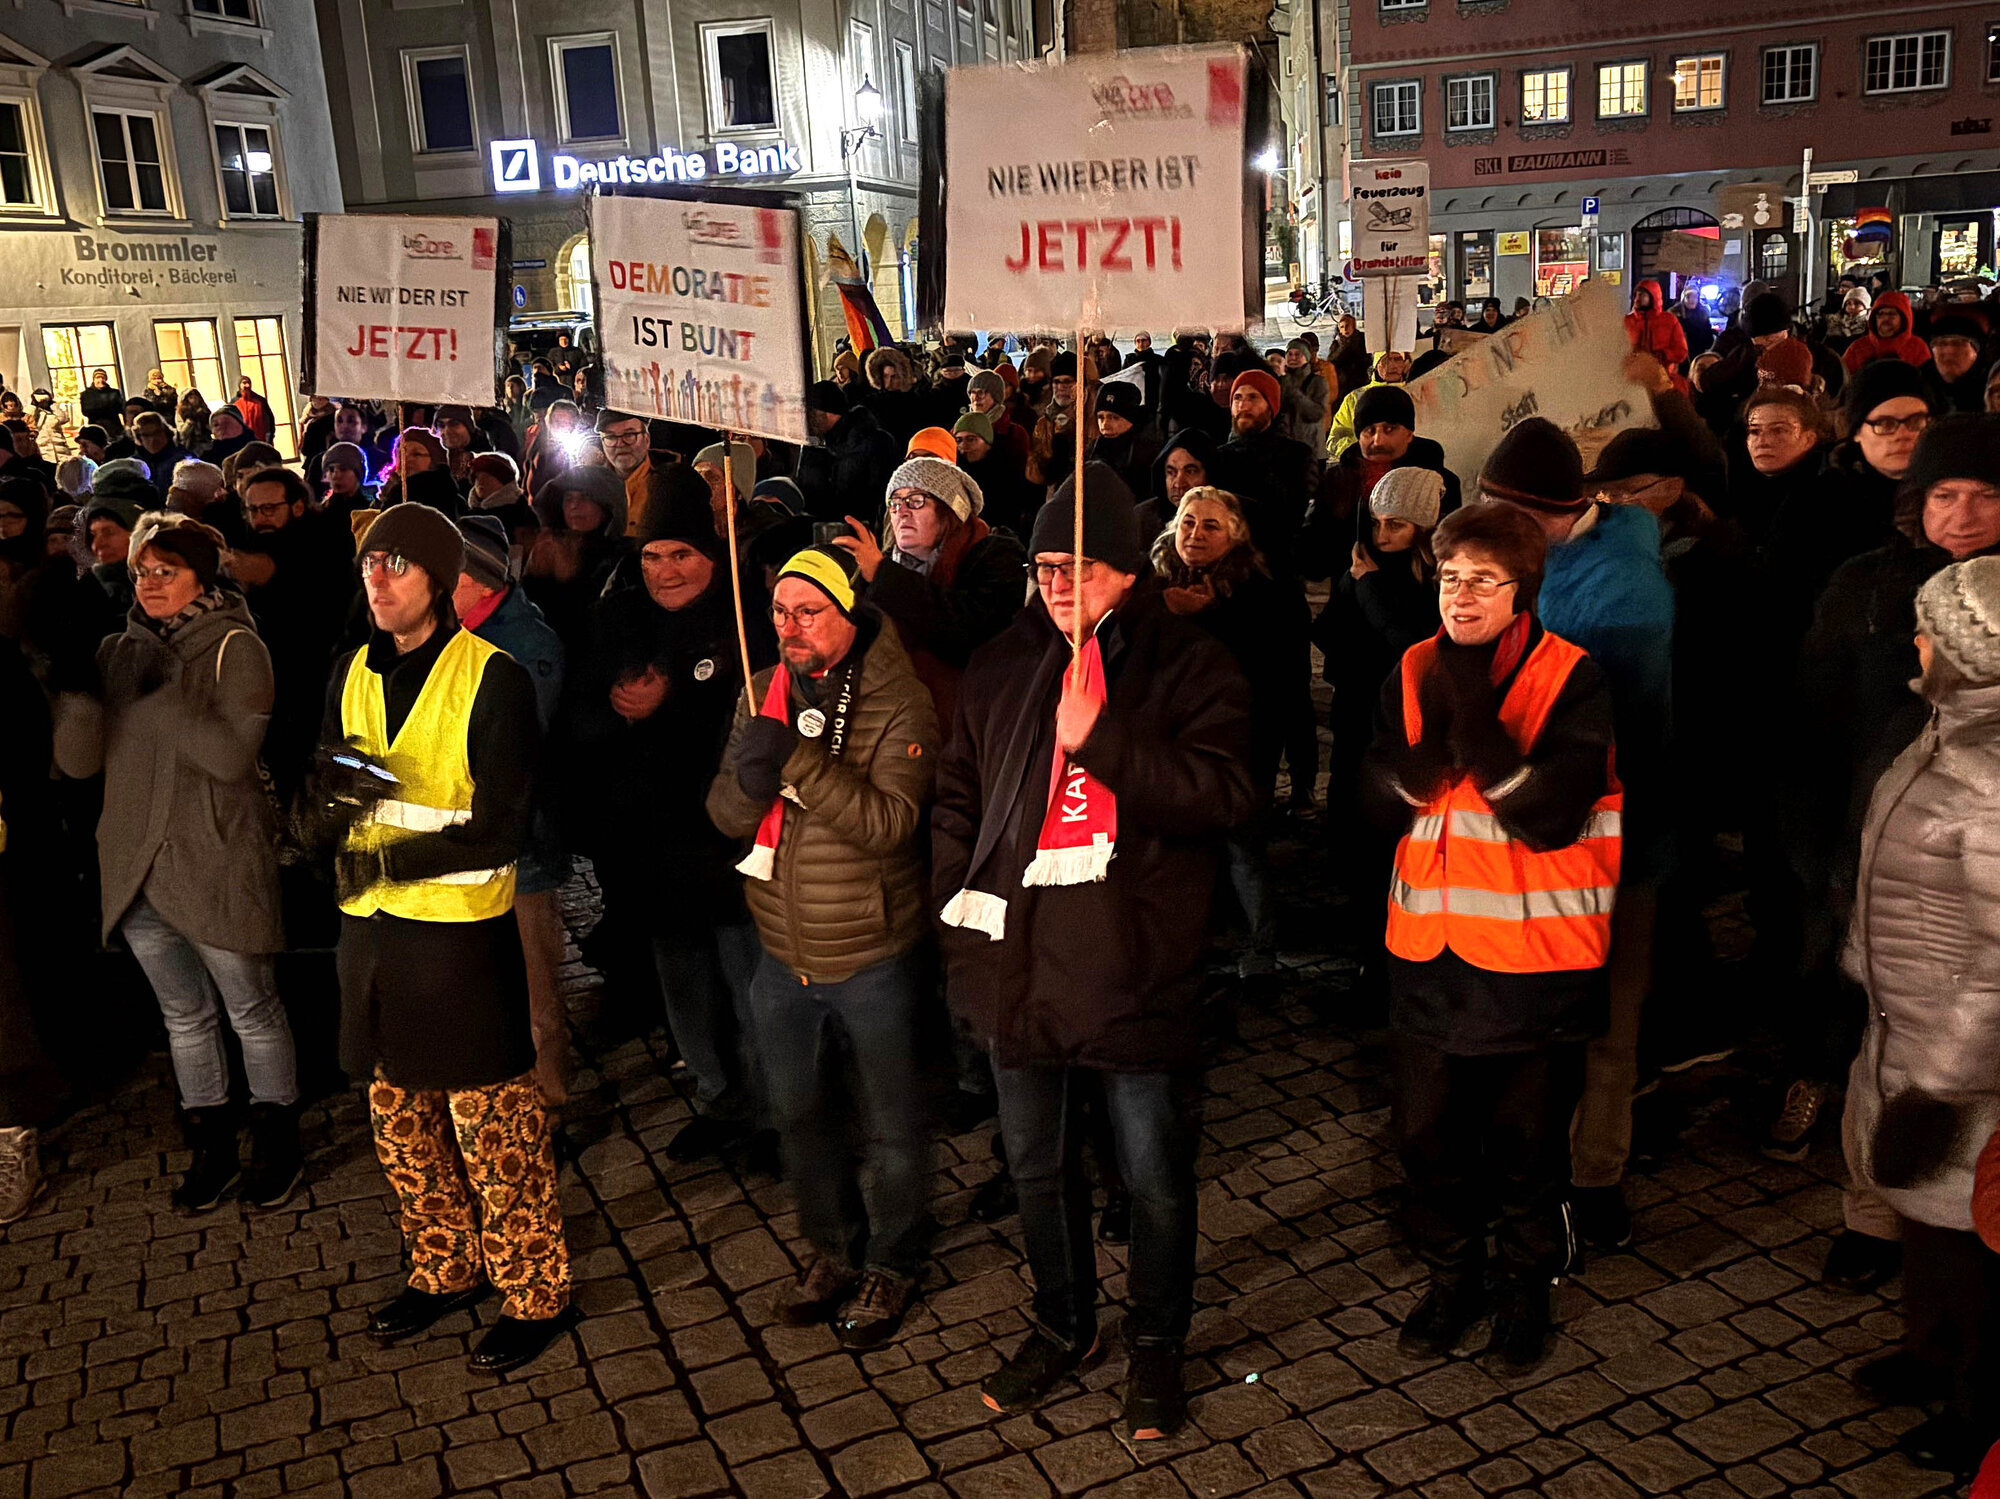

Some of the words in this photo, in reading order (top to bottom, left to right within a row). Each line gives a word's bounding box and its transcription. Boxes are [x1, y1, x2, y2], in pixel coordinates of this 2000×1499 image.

[553, 147, 706, 188] Deutsche
[716, 142, 800, 174] Bank
[1375, 168, 1402, 180] kein
[1476, 158, 1501, 174] SKL
[1512, 151, 1602, 171] BAUMANN
[988, 163, 1032, 199] NIE
[1038, 157, 1148, 195] WIEDER
[1155, 155, 1201, 190] IST
[1353, 186, 1425, 199] Feuerzeug
[1585, 199, 1596, 213] P
[74, 235, 217, 262] Brommler
[1005, 216, 1183, 272] JETZT!
[1381, 241, 1398, 251] für
[1353, 256, 1426, 270] Brandstifter
[60, 267, 153, 285] Konditorei
[169, 267, 238, 284] Bäckerei
[338, 286, 367, 303] NIE
[371, 287, 435, 306] WIDER
[441, 289, 470, 307] IST
[347, 325, 457, 361] JETZT!
[633, 316, 673, 348] IST
[681, 322, 756, 361] BUNT
[830, 717, 845, 756] DICH
